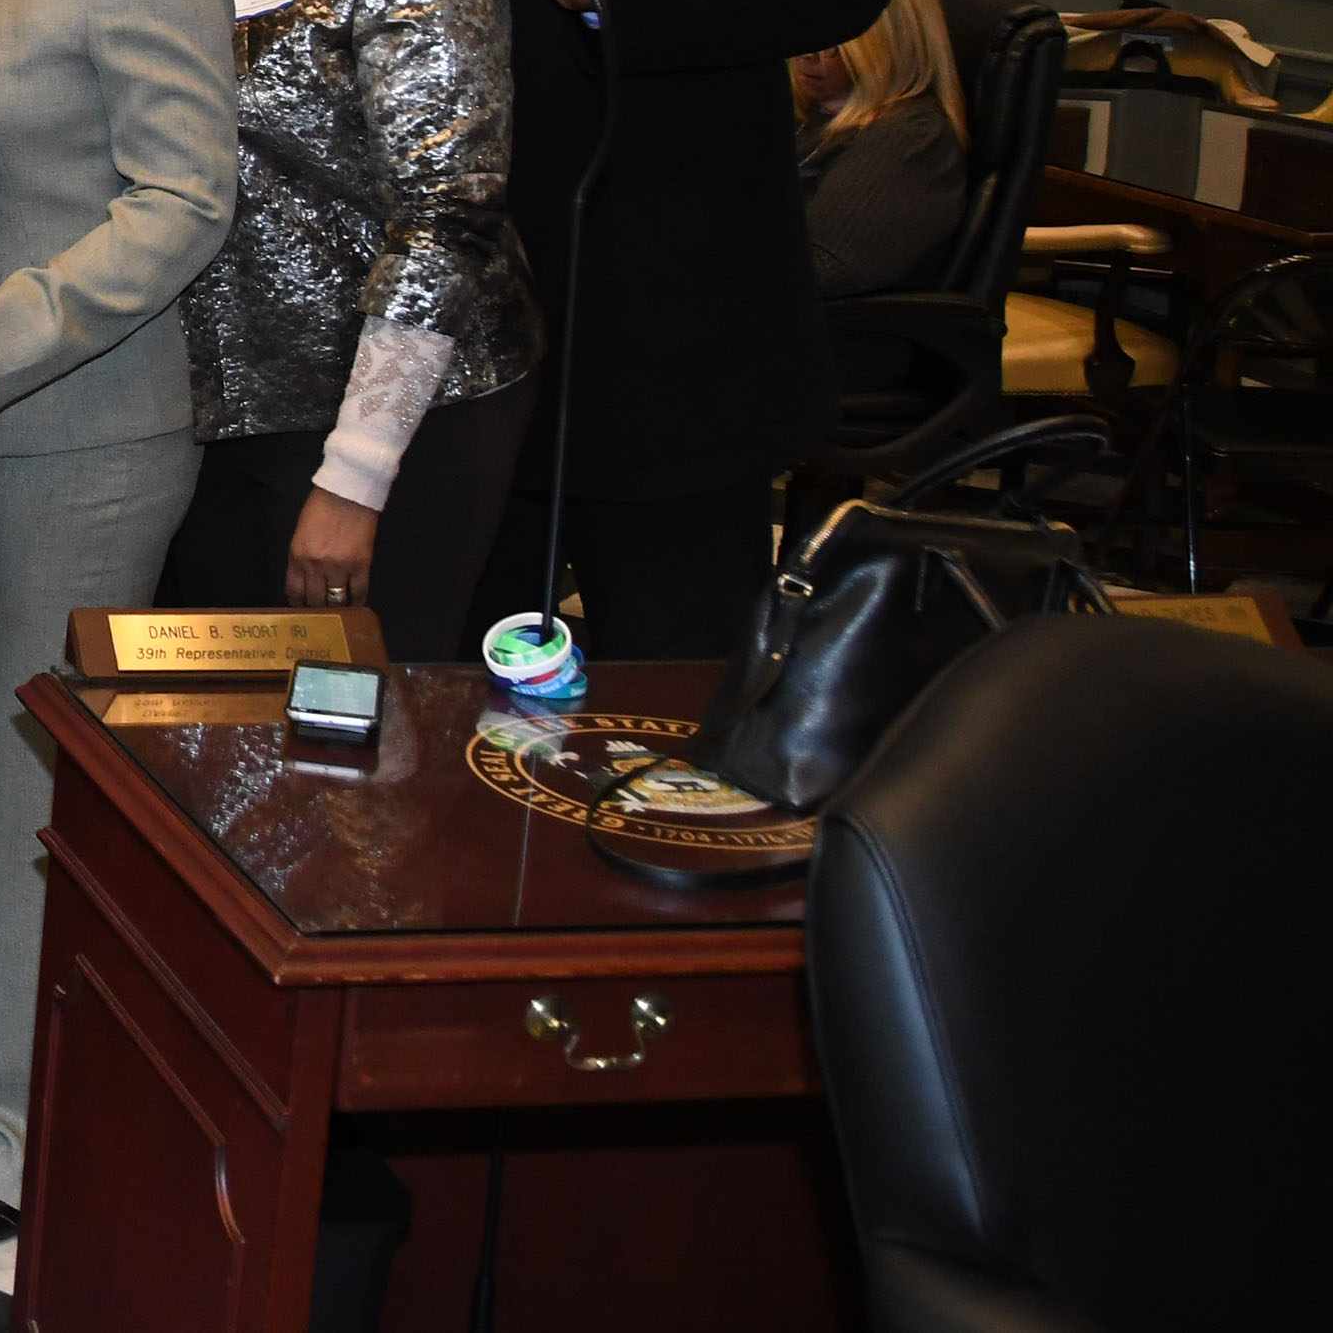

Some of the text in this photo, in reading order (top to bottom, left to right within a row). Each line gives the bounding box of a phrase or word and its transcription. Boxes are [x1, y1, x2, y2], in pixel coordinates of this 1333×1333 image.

[148, 625, 200, 640] DANIEL
[209, 625, 224, 639] B.
[233, 624, 279, 639] SHORT
[136, 647, 332, 662] 39th Representative District
[653, 826, 712, 844] 1704
